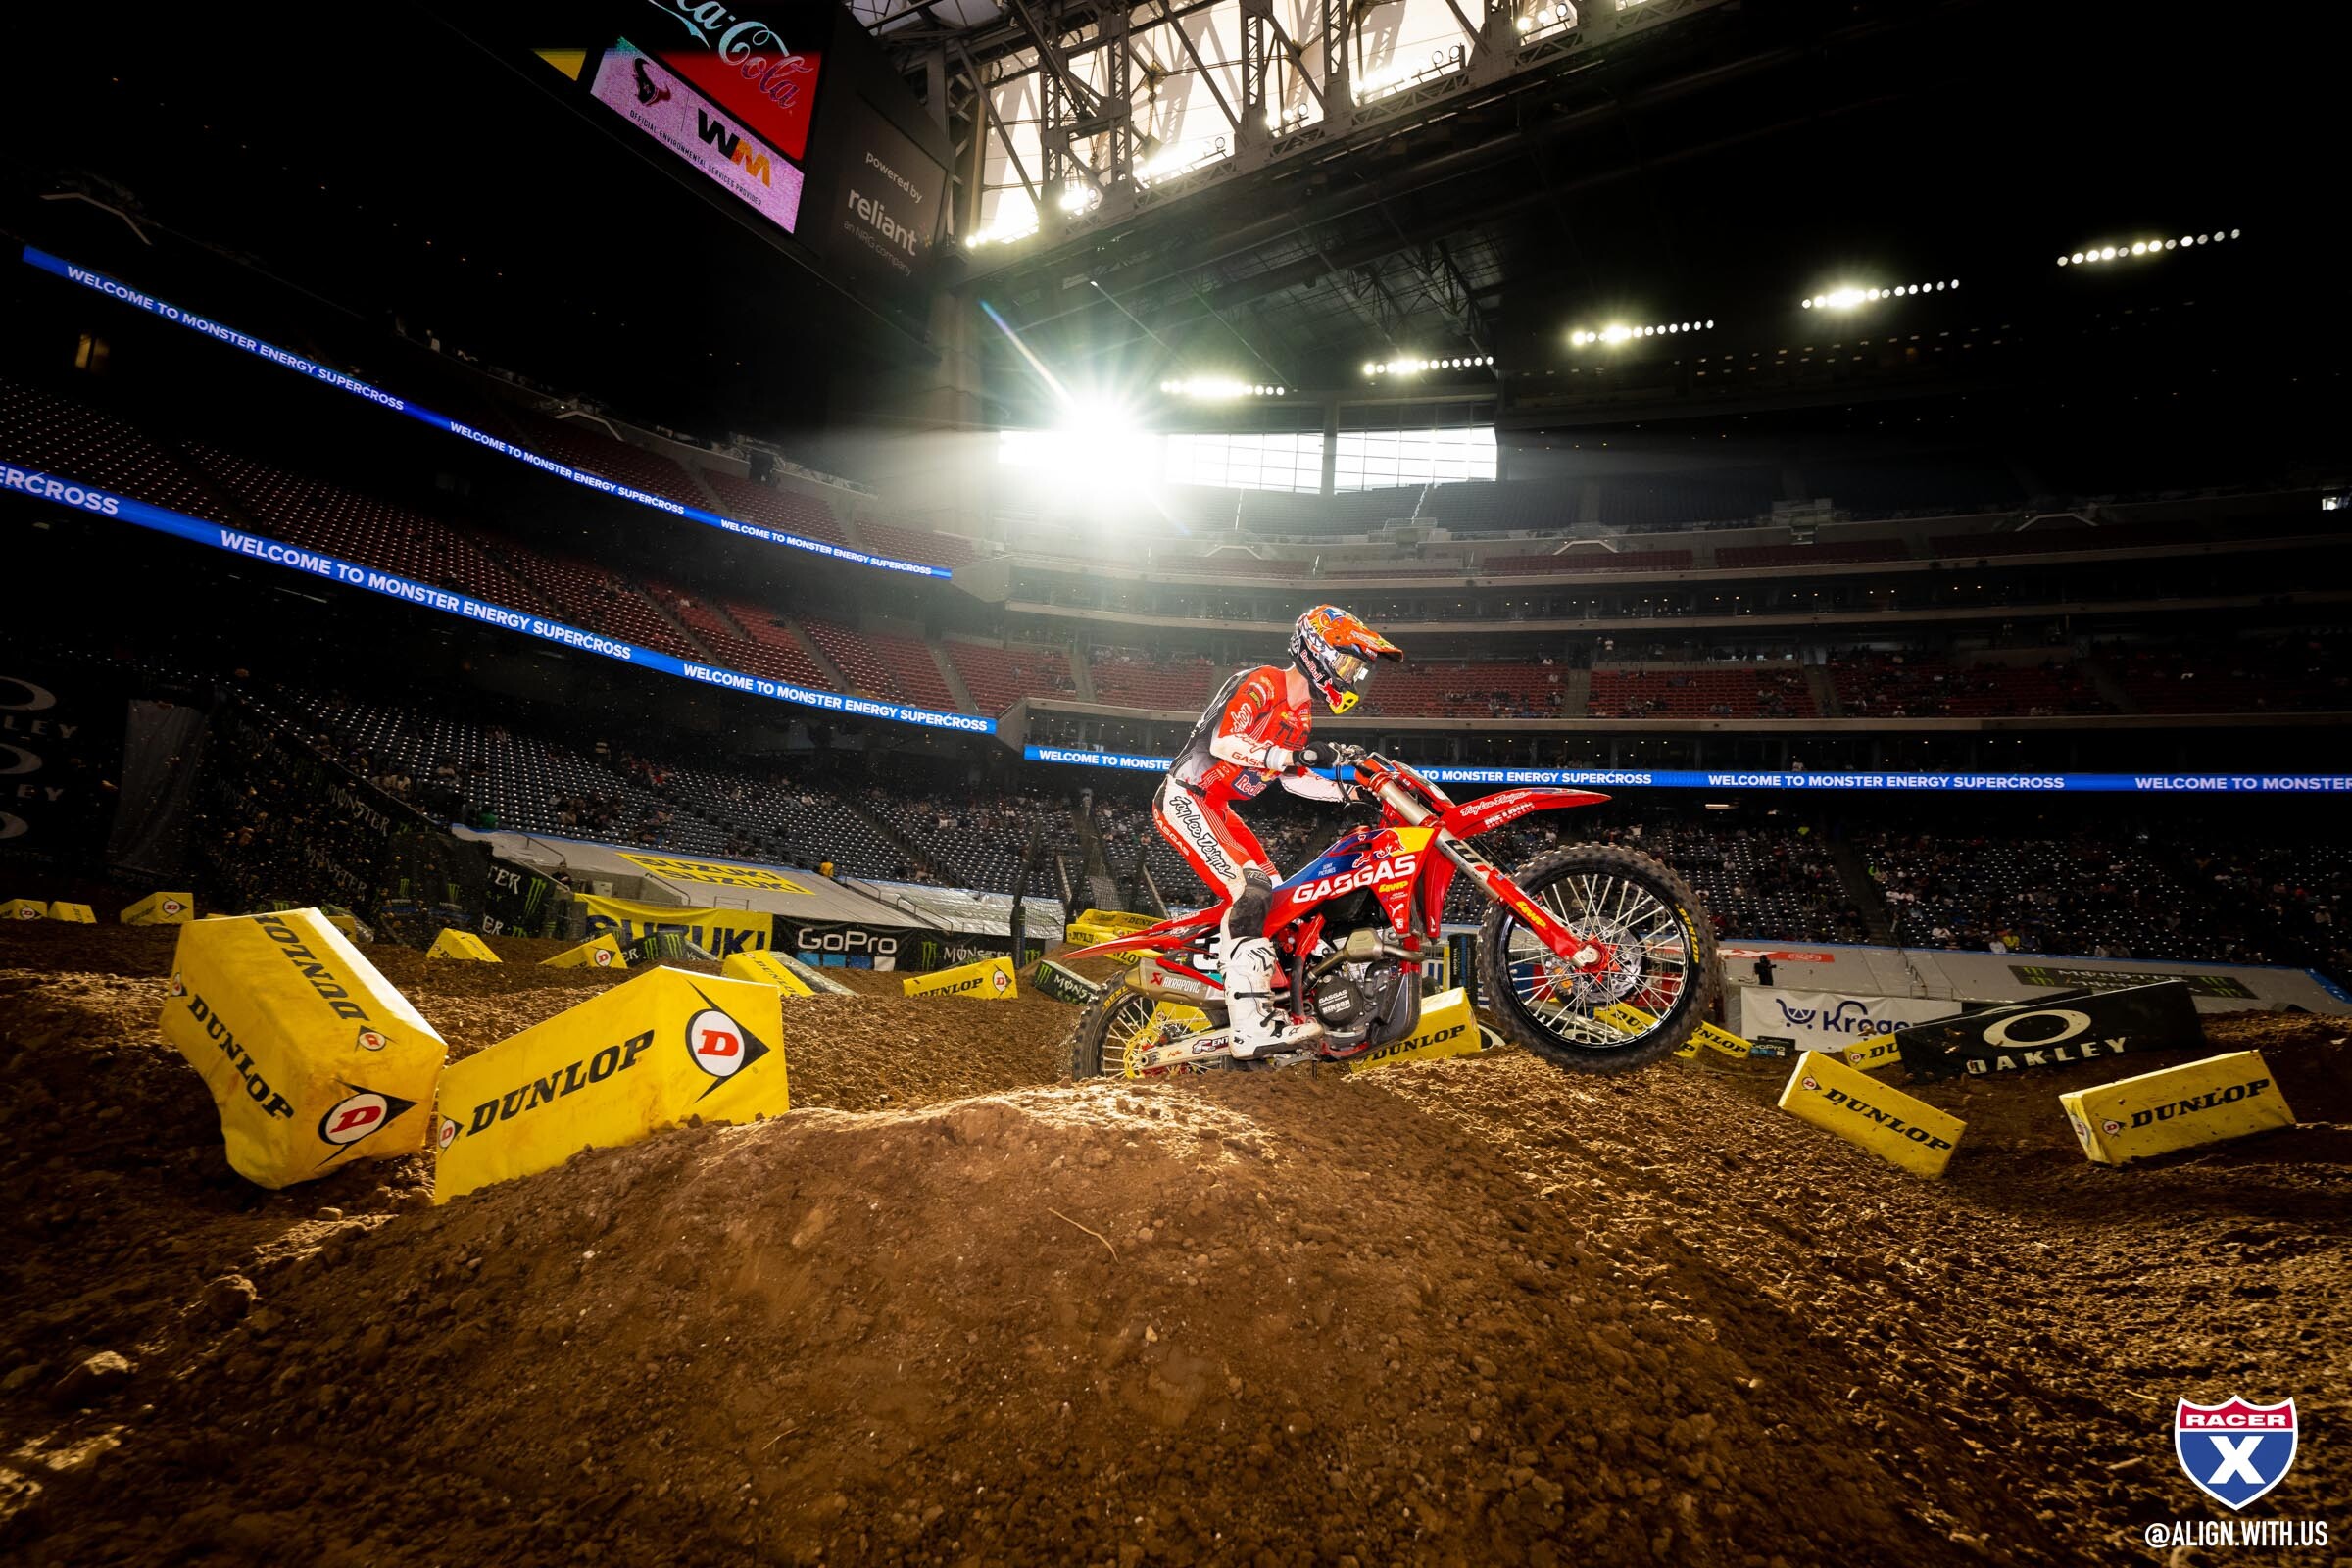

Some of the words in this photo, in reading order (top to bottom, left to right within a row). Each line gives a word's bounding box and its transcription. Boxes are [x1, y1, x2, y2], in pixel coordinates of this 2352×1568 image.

[629, 110, 658, 135] OFFICIAL
[659, 129, 707, 171] ENVIRONMENTAL
[708, 164, 735, 188] SERVICES
[735, 183, 762, 207] PROVIDER
[698, 109, 770, 188] WM
[865, 152, 910, 193] powered
[909, 185, 923, 204] by
[848, 189, 916, 257] reliant
[855, 226, 876, 249] NRG
[875, 244, 912, 277] company
[68, 266, 154, 310] WELCOME
[158, 302, 179, 320] TO
[182, 313, 258, 352] MONSTER
[259, 344, 317, 375] ENERGY
[318, 368, 406, 412] SUPERCROSS
[450, 421, 507, 452] WELCOME
[508, 445, 523, 459] TO
[523, 452, 573, 479] MONSTER
[574, 472, 617, 493] ENERGY
[618, 487, 685, 515] SUPERCROSS
[721, 519, 770, 539] WELCOME
[772, 532, 786, 543] TO
[786, 536, 832, 555] MONSTER
[833, 548, 870, 564] ENERGY
[870, 557, 932, 576] SUPERCROSS
[220, 529, 332, 576] WELCOME
[337, 564, 365, 584] TO
[368, 573, 460, 612] MONSTER
[463, 601, 531, 631] ENERGY
[532, 620, 632, 661] SUPERCROSS
[683, 663, 754, 692] WELCOME
[757, 680, 774, 695] TO
[776, 687, 843, 710] MONSTER
[844, 699, 899, 719] ENERGY
[900, 709, 988, 732] SUPERCROSS
[1039, 750, 1100, 764] WELCOME
[1102, 755, 1118, 766] TO
[1442, 770, 1504, 783] MONSTER
[1506, 771, 1560, 784] ENERGY
[1561, 772, 1652, 785] SUPERCROSS
[1708, 774, 1782, 786] WELCOME
[1785, 774, 1805, 787] TO
[1808, 775, 1883, 787] MONSTER
[1886, 776, 1950, 789] ENERGY
[1953, 776, 2065, 790] SUPERCROSS
[2134, 777, 2228, 789] WELCOME
[2231, 777, 2257, 790] TO
[1292, 855, 1417, 904] GASGAS
[797, 927, 898, 955] GoPro
[1678, 906, 1700, 964] DUNLOP
[1318, 989, 1348, 1004] GASGAS
[1823, 1001, 1911, 1036] Kroge
[187, 994, 294, 1120] DUNLOP
[1372, 1024, 1466, 1061] DUNLOP
[1966, 1036, 2129, 1076] OAKLEY
[466, 1029, 655, 1138] DUNLOP
[2131, 1078, 2272, 1129] DUNLOP
[1823, 1087, 1953, 1152] DUNLOP
